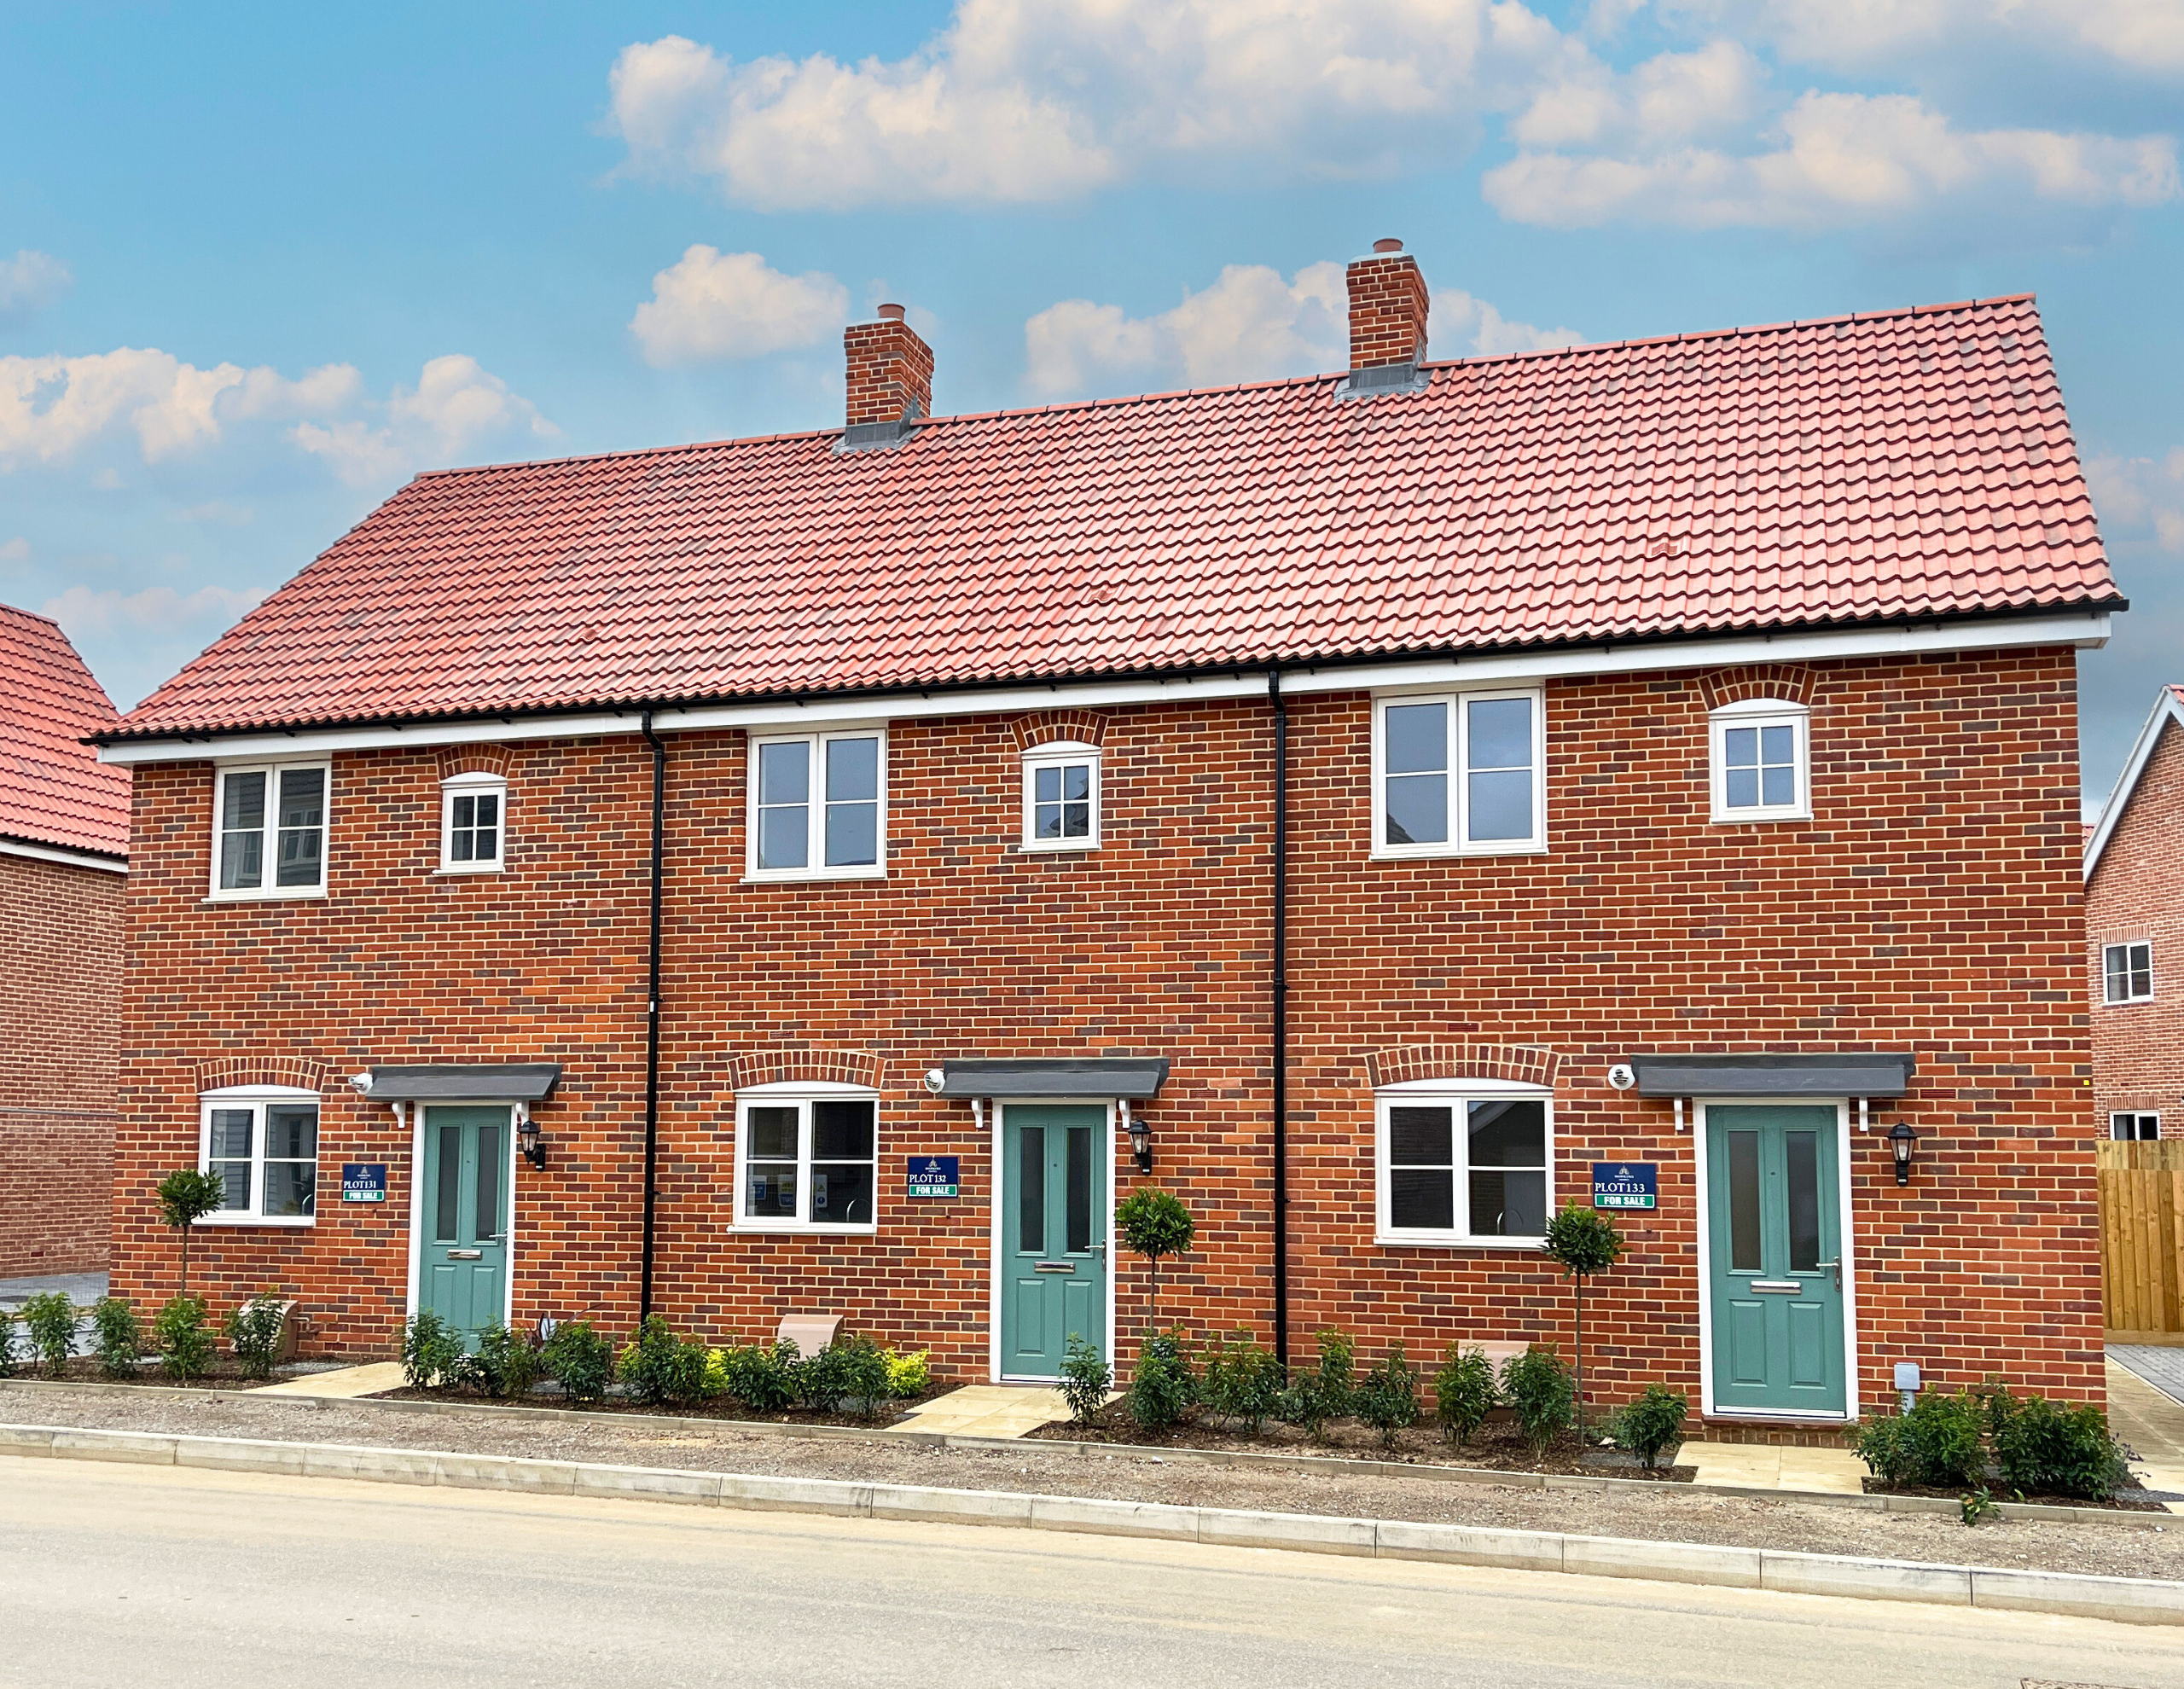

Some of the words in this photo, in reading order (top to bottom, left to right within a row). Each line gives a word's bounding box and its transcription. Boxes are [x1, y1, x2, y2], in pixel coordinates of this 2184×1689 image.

[909, 1174, 934, 1183] PLOT
[934, 1174, 947, 1183] 132
[915, 1186, 931, 1194] FOR
[932, 1186, 950, 1194] SALE
[1604, 1196, 1622, 1205] FOR
[1623, 1196, 1646, 1206] SALE
